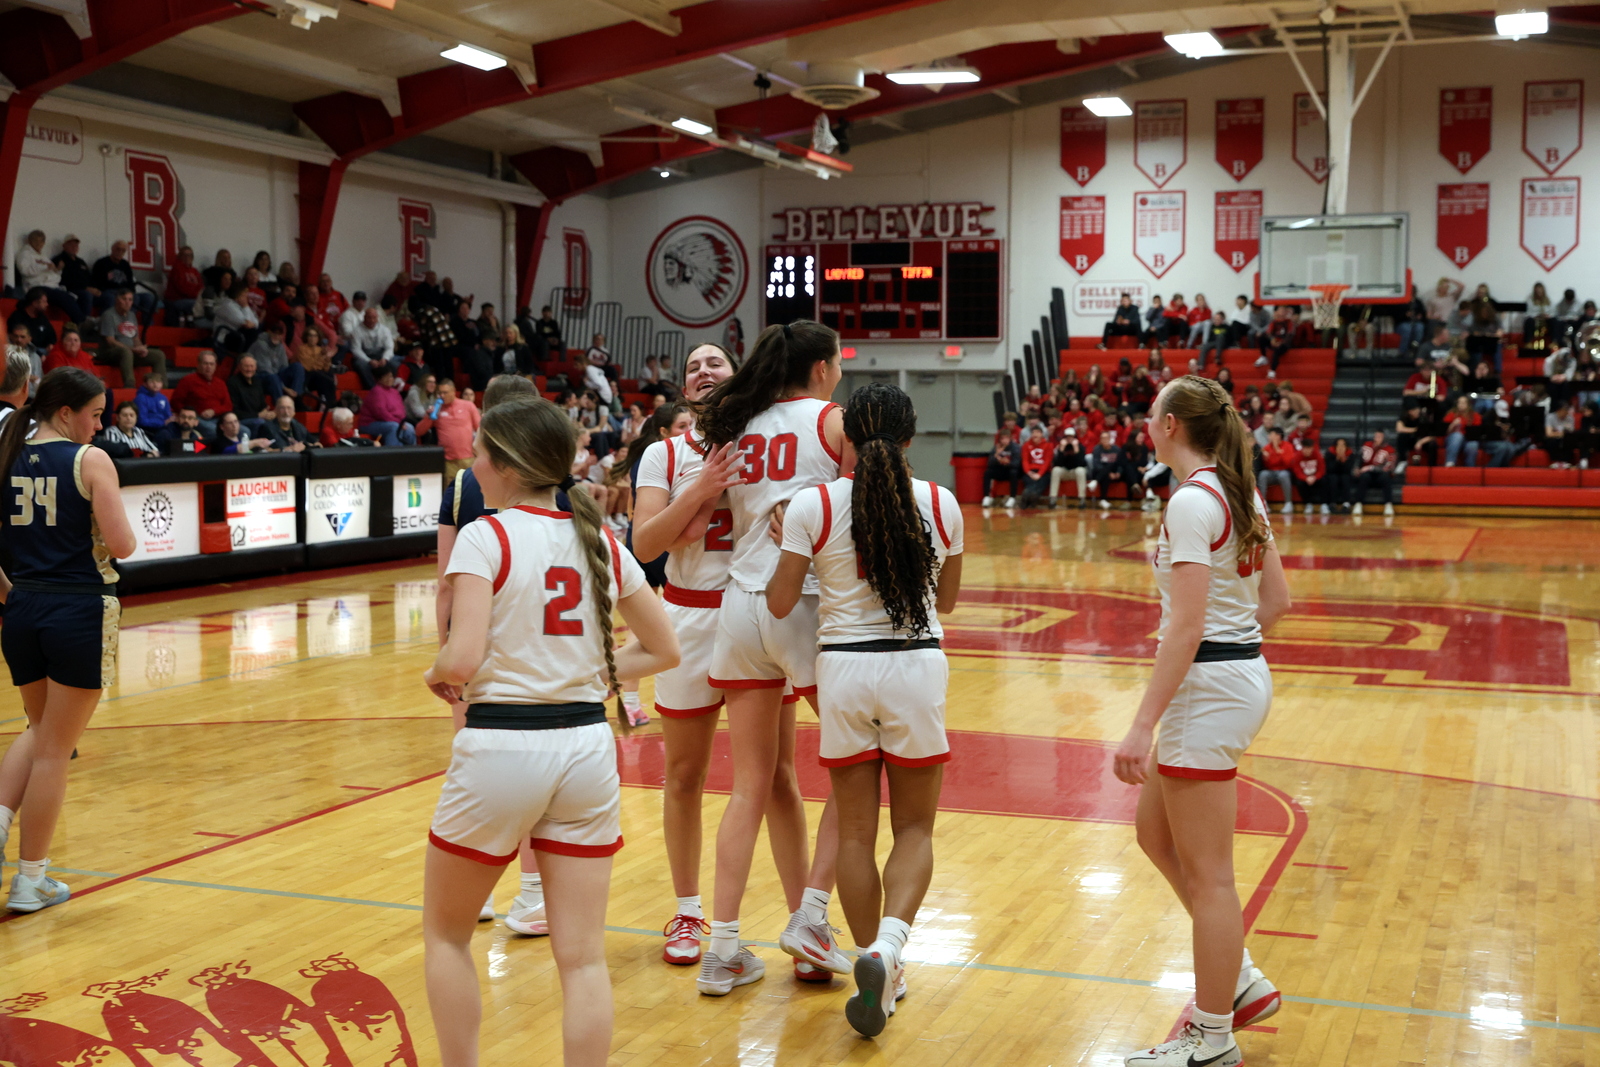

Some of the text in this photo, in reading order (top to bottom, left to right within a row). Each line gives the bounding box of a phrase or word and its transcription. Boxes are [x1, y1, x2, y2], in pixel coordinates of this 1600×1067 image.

[1232, 160, 1246, 176] B
[1457, 152, 1472, 168] B
[1077, 166, 1090, 182] B
[1153, 163, 1166, 178] B
[125, 149, 179, 272] R
[786, 203, 982, 241] BELLEVUE
[1231, 251, 1245, 267] B
[1455, 246, 1469, 263] B
[1543, 244, 1556, 260] B
[1075, 255, 1088, 270] B
[1153, 253, 1165, 268] B
[738, 432, 798, 485] 30
[231, 480, 288, 497] LAUGHLIN
[10, 476, 58, 527] 34
[393, 513, 439, 530] BECK'S
[543, 566, 584, 636] 2
